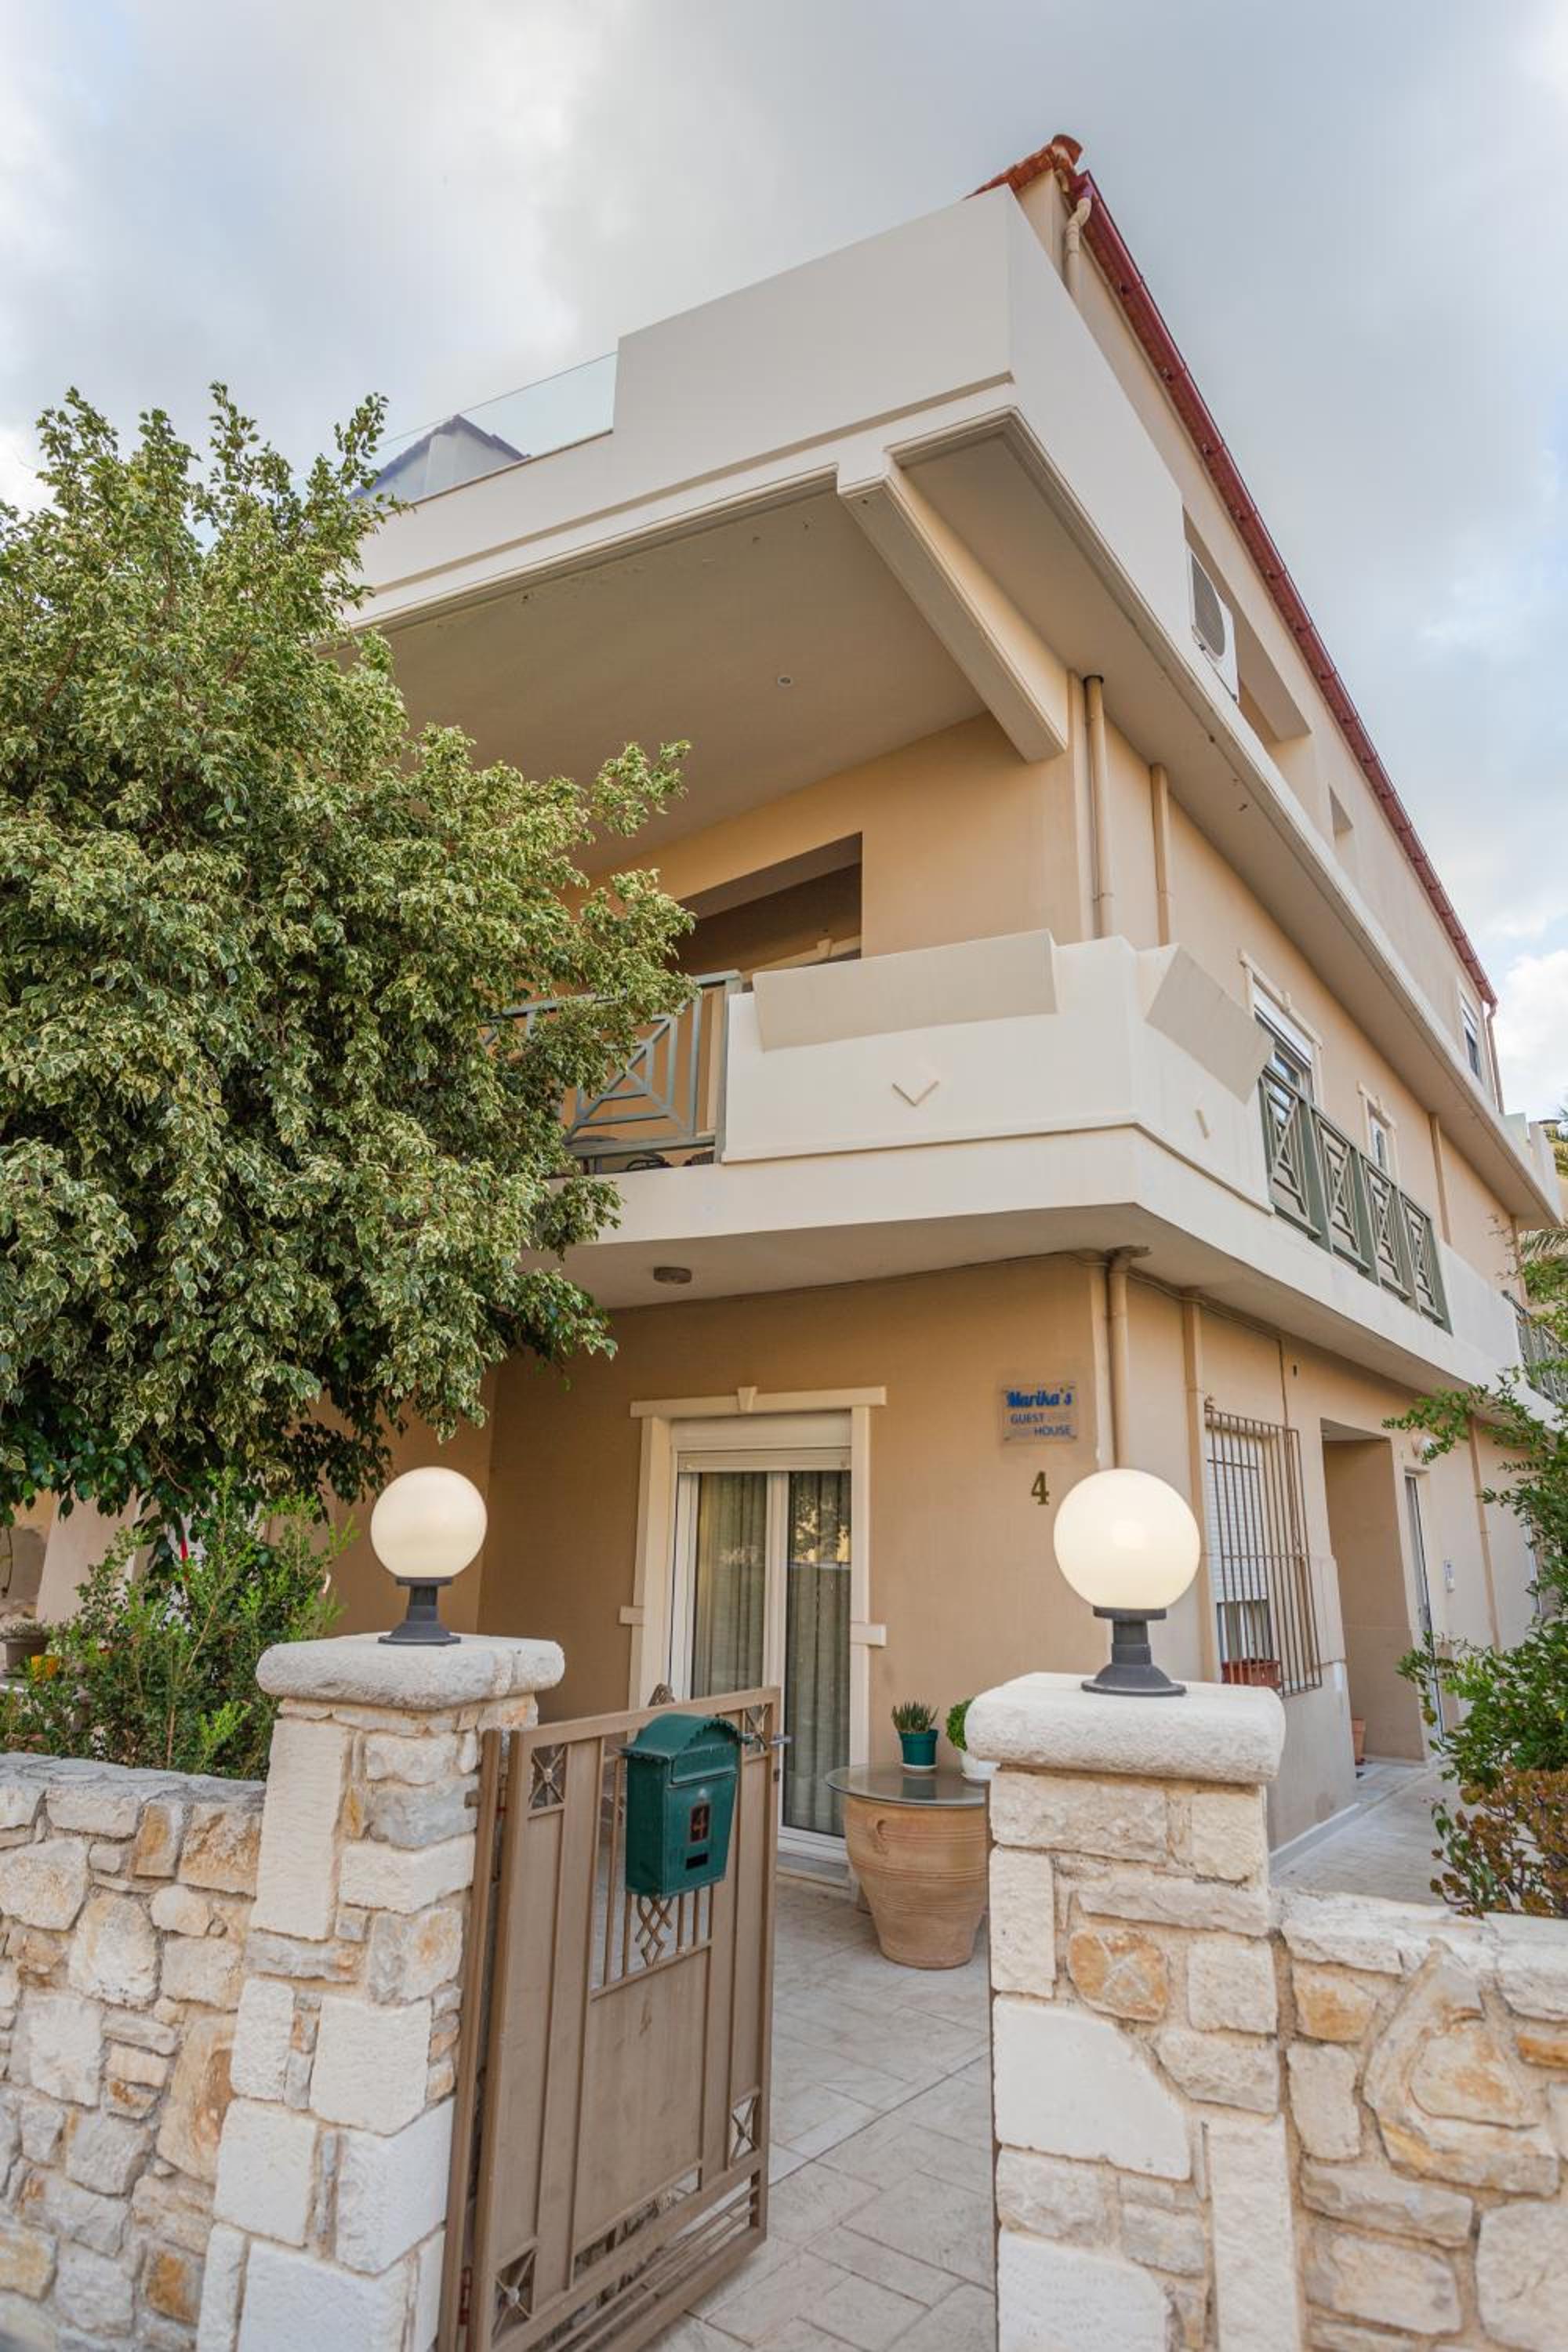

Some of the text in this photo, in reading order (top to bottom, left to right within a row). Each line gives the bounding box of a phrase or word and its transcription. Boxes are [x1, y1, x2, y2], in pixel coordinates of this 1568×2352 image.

[1006, 1388, 1073, 1407] Marika's
[1011, 1413, 1045, 1425] GUEST
[1034, 1425, 1073, 1436] HOUSE
[1031, 1470, 1050, 1505] 4
[693, 1807, 706, 1839] 4
